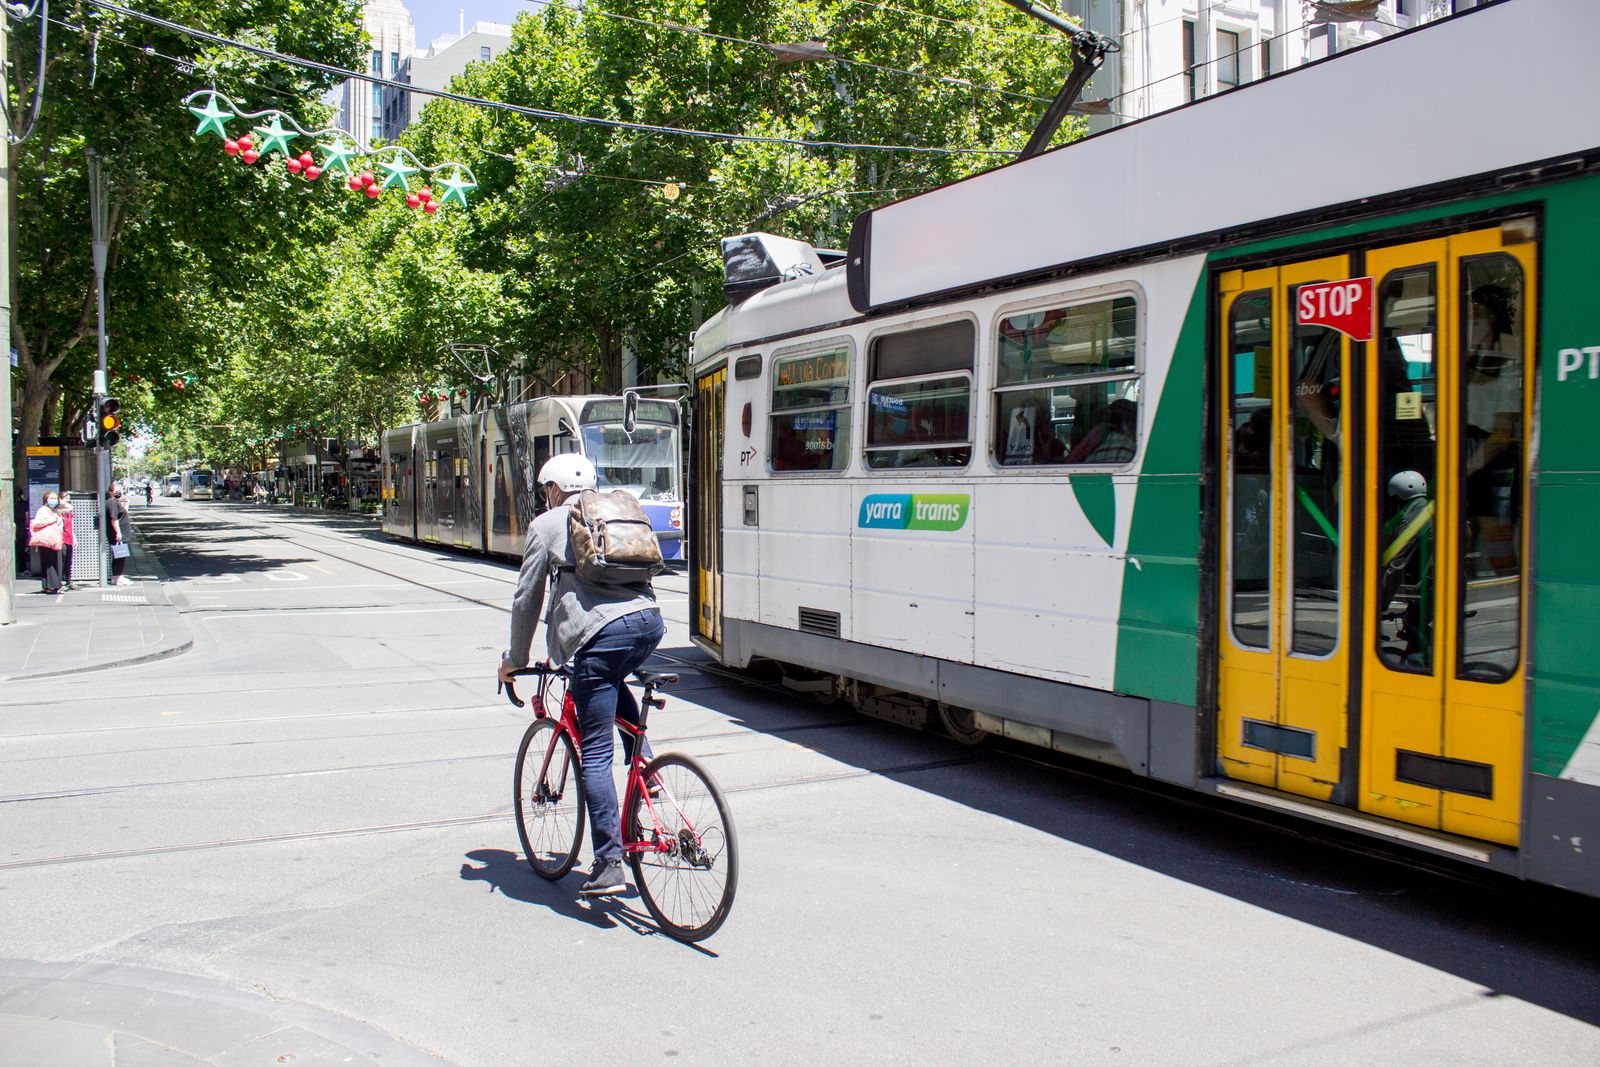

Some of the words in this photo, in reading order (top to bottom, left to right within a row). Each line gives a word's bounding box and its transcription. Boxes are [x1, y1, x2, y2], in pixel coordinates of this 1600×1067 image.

[176, 63, 193, 74] 201
[1299, 282, 1363, 321] STOP
[1557, 345, 1600, 382] PT
[740, 451, 751, 467] PT
[865, 501, 902, 524] yarra
[915, 499, 960, 522] trams
